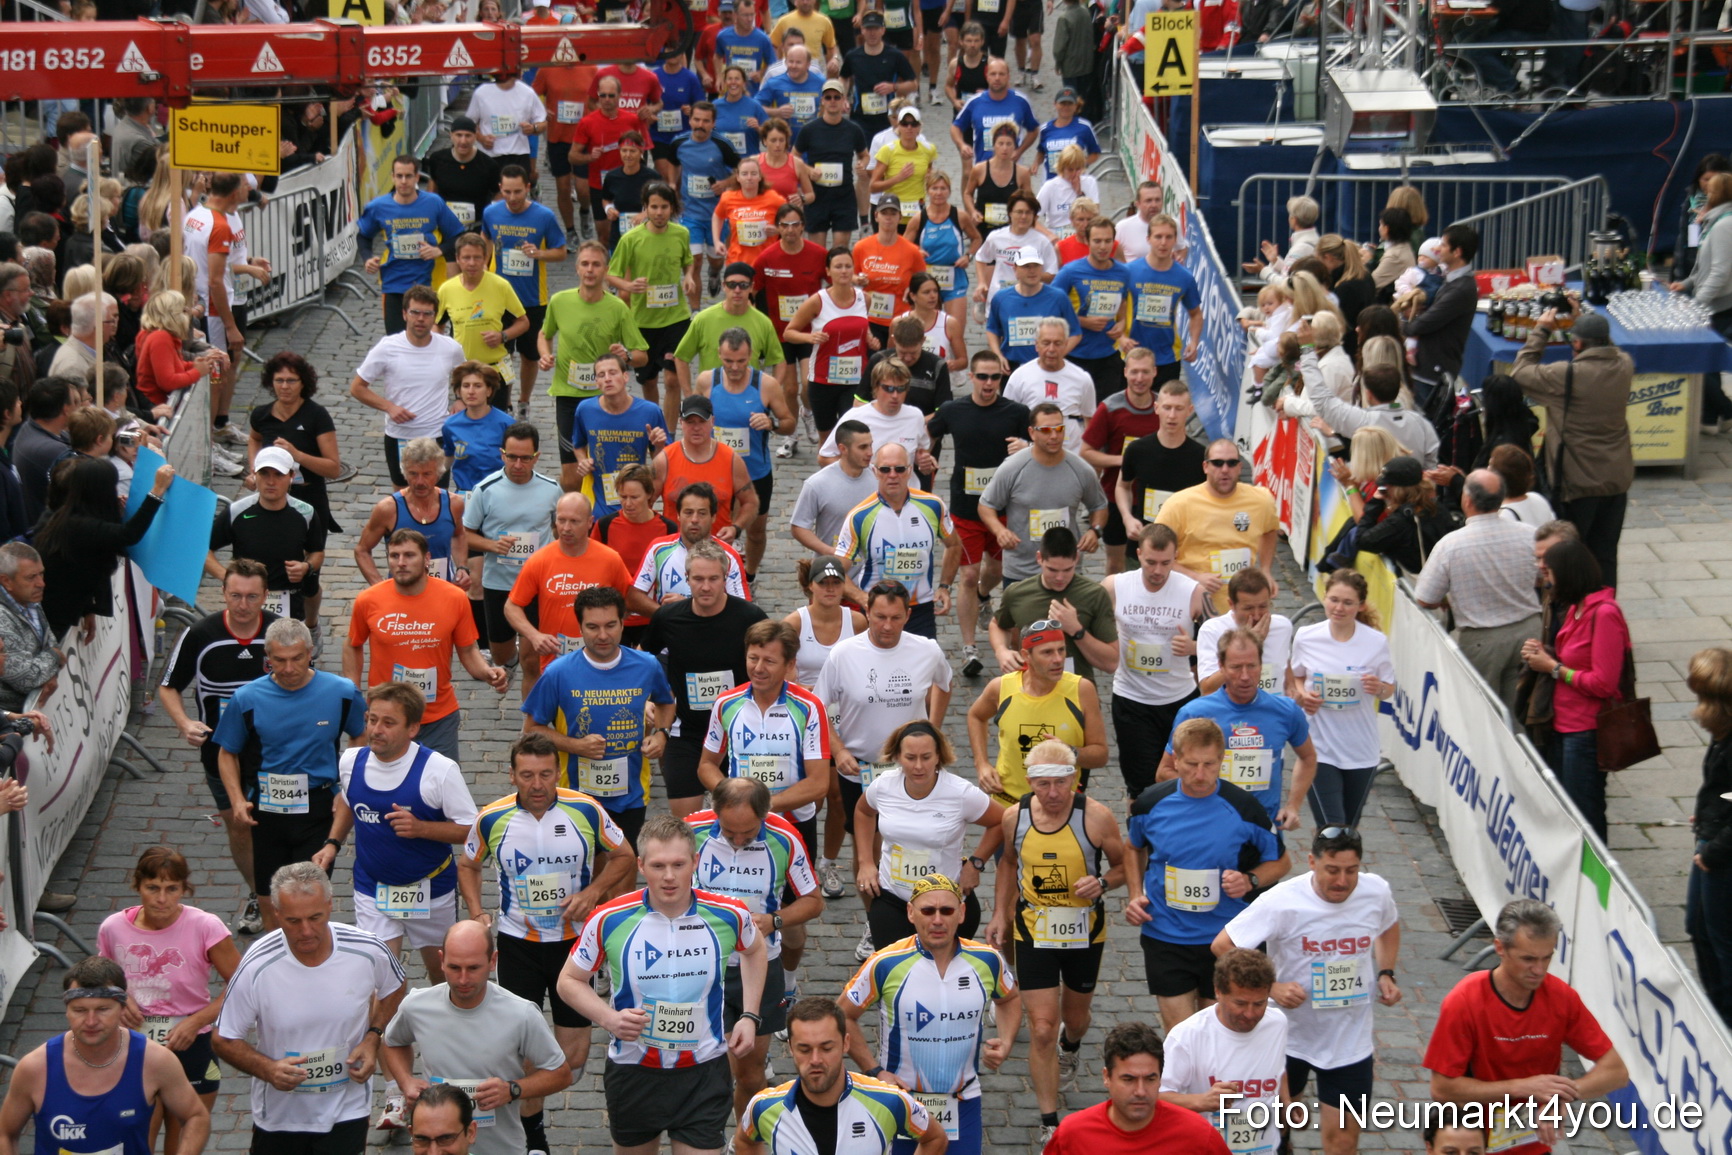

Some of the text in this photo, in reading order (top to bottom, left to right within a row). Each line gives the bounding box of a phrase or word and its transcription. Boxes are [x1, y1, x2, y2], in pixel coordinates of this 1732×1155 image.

[1152, 17, 1193, 32] Block
[44, 48, 105, 69] 6352
[367, 45, 422, 67] 6352
[1156, 38, 1187, 77] A
[619, 99, 641, 108] DAV
[178, 117, 273, 138] Schnupper-
[210, 138, 241, 155] lauf
[824, 172, 838, 180] 990
[747, 231, 762, 239] 393
[511, 259, 530, 268] 3794
[868, 261, 900, 271] Fischer
[659, 292, 674, 300] 462
[873, 303, 889, 311] 874
[1099, 303, 1117, 311] 2621
[1147, 305, 1167, 313] 2620
[839, 367, 858, 375] 2539
[1627, 377, 1686, 402] ossner
[598, 430, 644, 438] NEUMARKTER
[596, 436, 635, 444] STADTLAUF
[726, 440, 743, 448] 735
[510, 544, 535, 554] 3288
[899, 540, 929, 549] PLAST
[897, 560, 923, 570] 2655
[1223, 561, 1248, 573] 1005
[555, 581, 600, 591] Fischer
[1123, 604, 1183, 619] AÉROPOSTALE
[387, 620, 435, 631] Fischer
[1144, 616, 1160, 625] NYC
[1141, 656, 1163, 666] 999
[405, 670, 425, 679] Robert
[698, 675, 720, 683] Markus
[571, 688, 643, 698] 10. NEUMARKTER
[701, 685, 729, 697] 2973
[1327, 688, 1356, 698] 2950
[583, 697, 632, 706] STADTLAUF
[878, 696, 912, 704] Neumarkter
[606, 731, 639, 740] 20.09.2009
[760, 733, 790, 741] PLAST
[1229, 735, 1263, 748] CHALLENGE
[1233, 754, 1256, 762] Rainer
[591, 763, 613, 771] Harald
[752, 760, 775, 768] Konrad
[753, 771, 785, 783] 2654
[1239, 766, 1262, 778] 751
[270, 777, 299, 786] Christian
[595, 774, 620, 786] 825
[272, 789, 304, 800] 2844
[538, 855, 578, 865] PLAST
[729, 866, 765, 876] PLAST
[904, 864, 937, 877] 1103
[530, 879, 544, 887] Max
[392, 891, 424, 903] 2670
[532, 888, 566, 902] 2653
[1184, 886, 1210, 898] 983
[1051, 922, 1083, 935] 1051
[1302, 936, 1371, 955] kago
[668, 947, 708, 958] PLAST
[637, 970, 708, 980] www.tr-plast.de
[1328, 965, 1351, 975] Stefan
[1329, 976, 1363, 992] 2374
[658, 1005, 693, 1016] Reinhard
[940, 1010, 979, 1021] PLAST
[657, 1020, 695, 1034] 3290
[908, 1032, 976, 1043] www.tr-plast.de
[306, 1062, 343, 1079] 3299
[917, 1096, 947, 1106] Matthias
